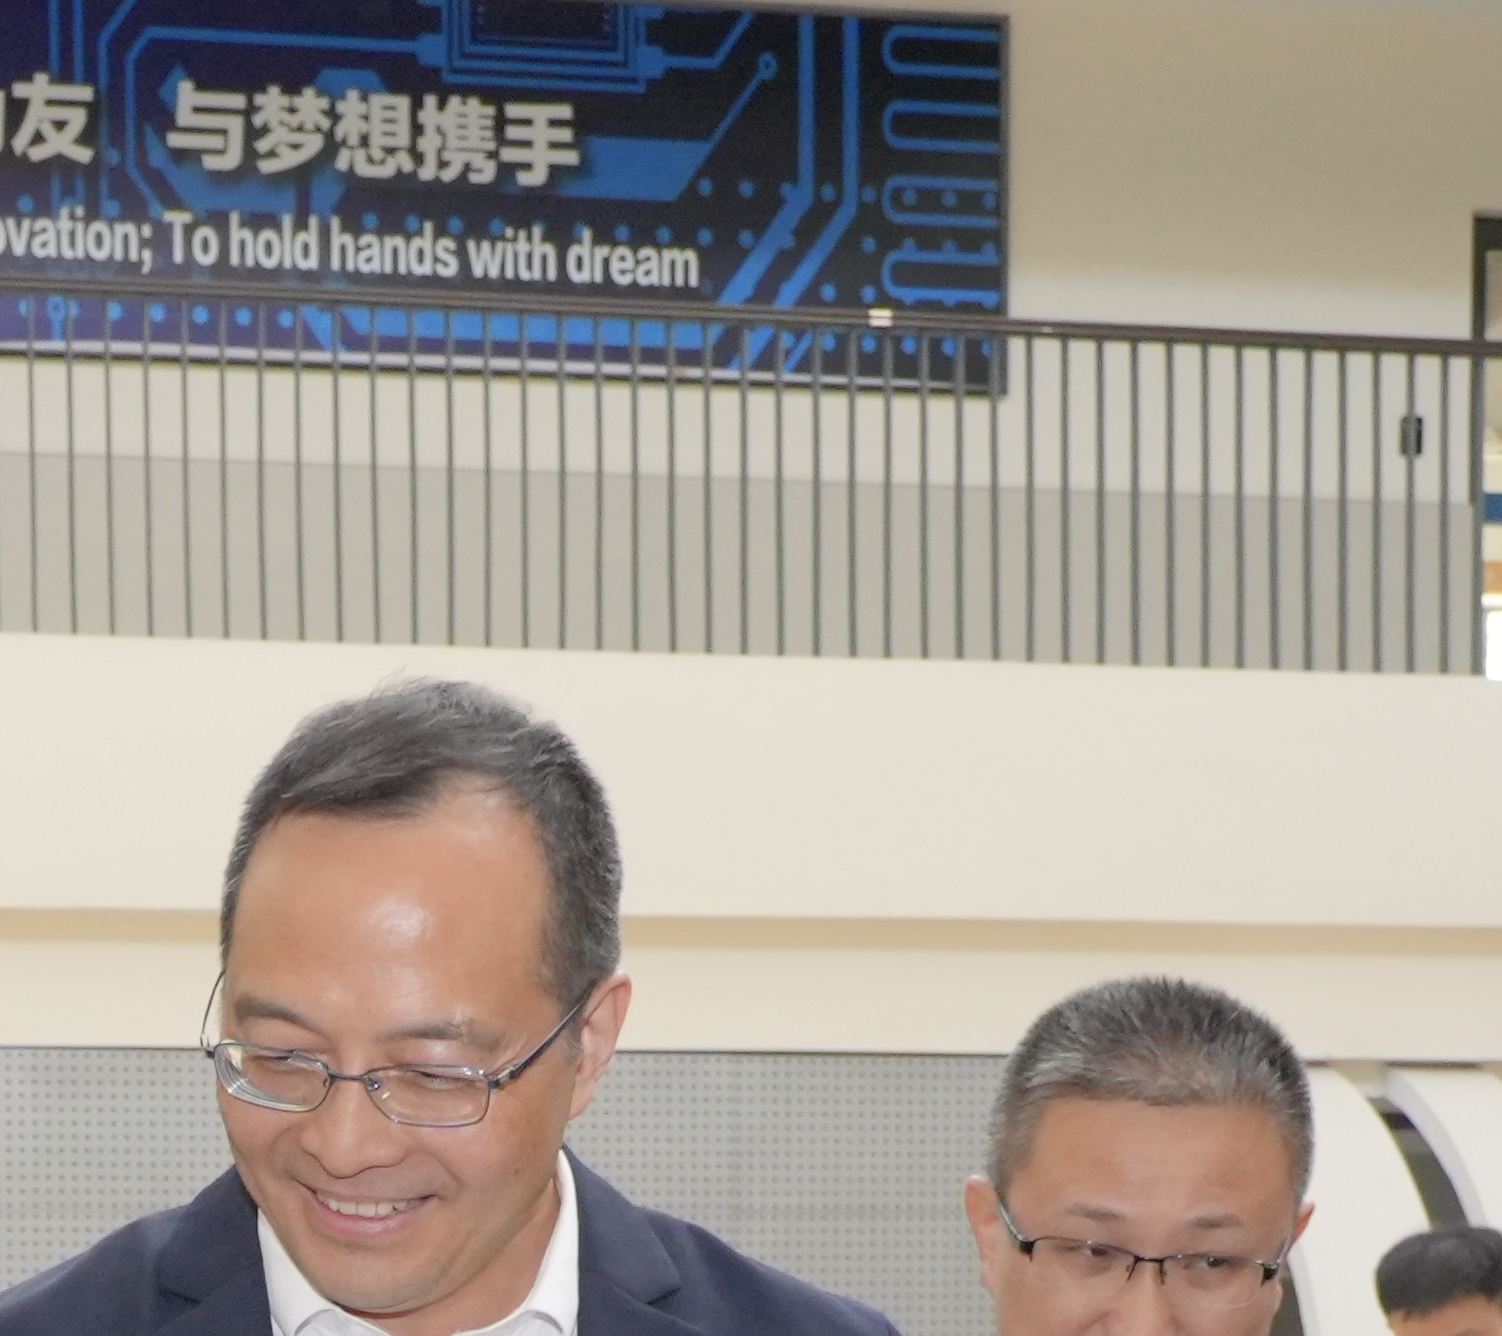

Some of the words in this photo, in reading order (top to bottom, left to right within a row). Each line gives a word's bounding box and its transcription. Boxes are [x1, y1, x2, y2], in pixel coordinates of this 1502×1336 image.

[166, 79, 581, 187] 与梦想携手
[161, 210, 219, 266] To
[228, 210, 319, 271] hold
[330, 216, 459, 278] hands
[467, 222, 556, 283] with
[566, 224, 700, 288] dream
